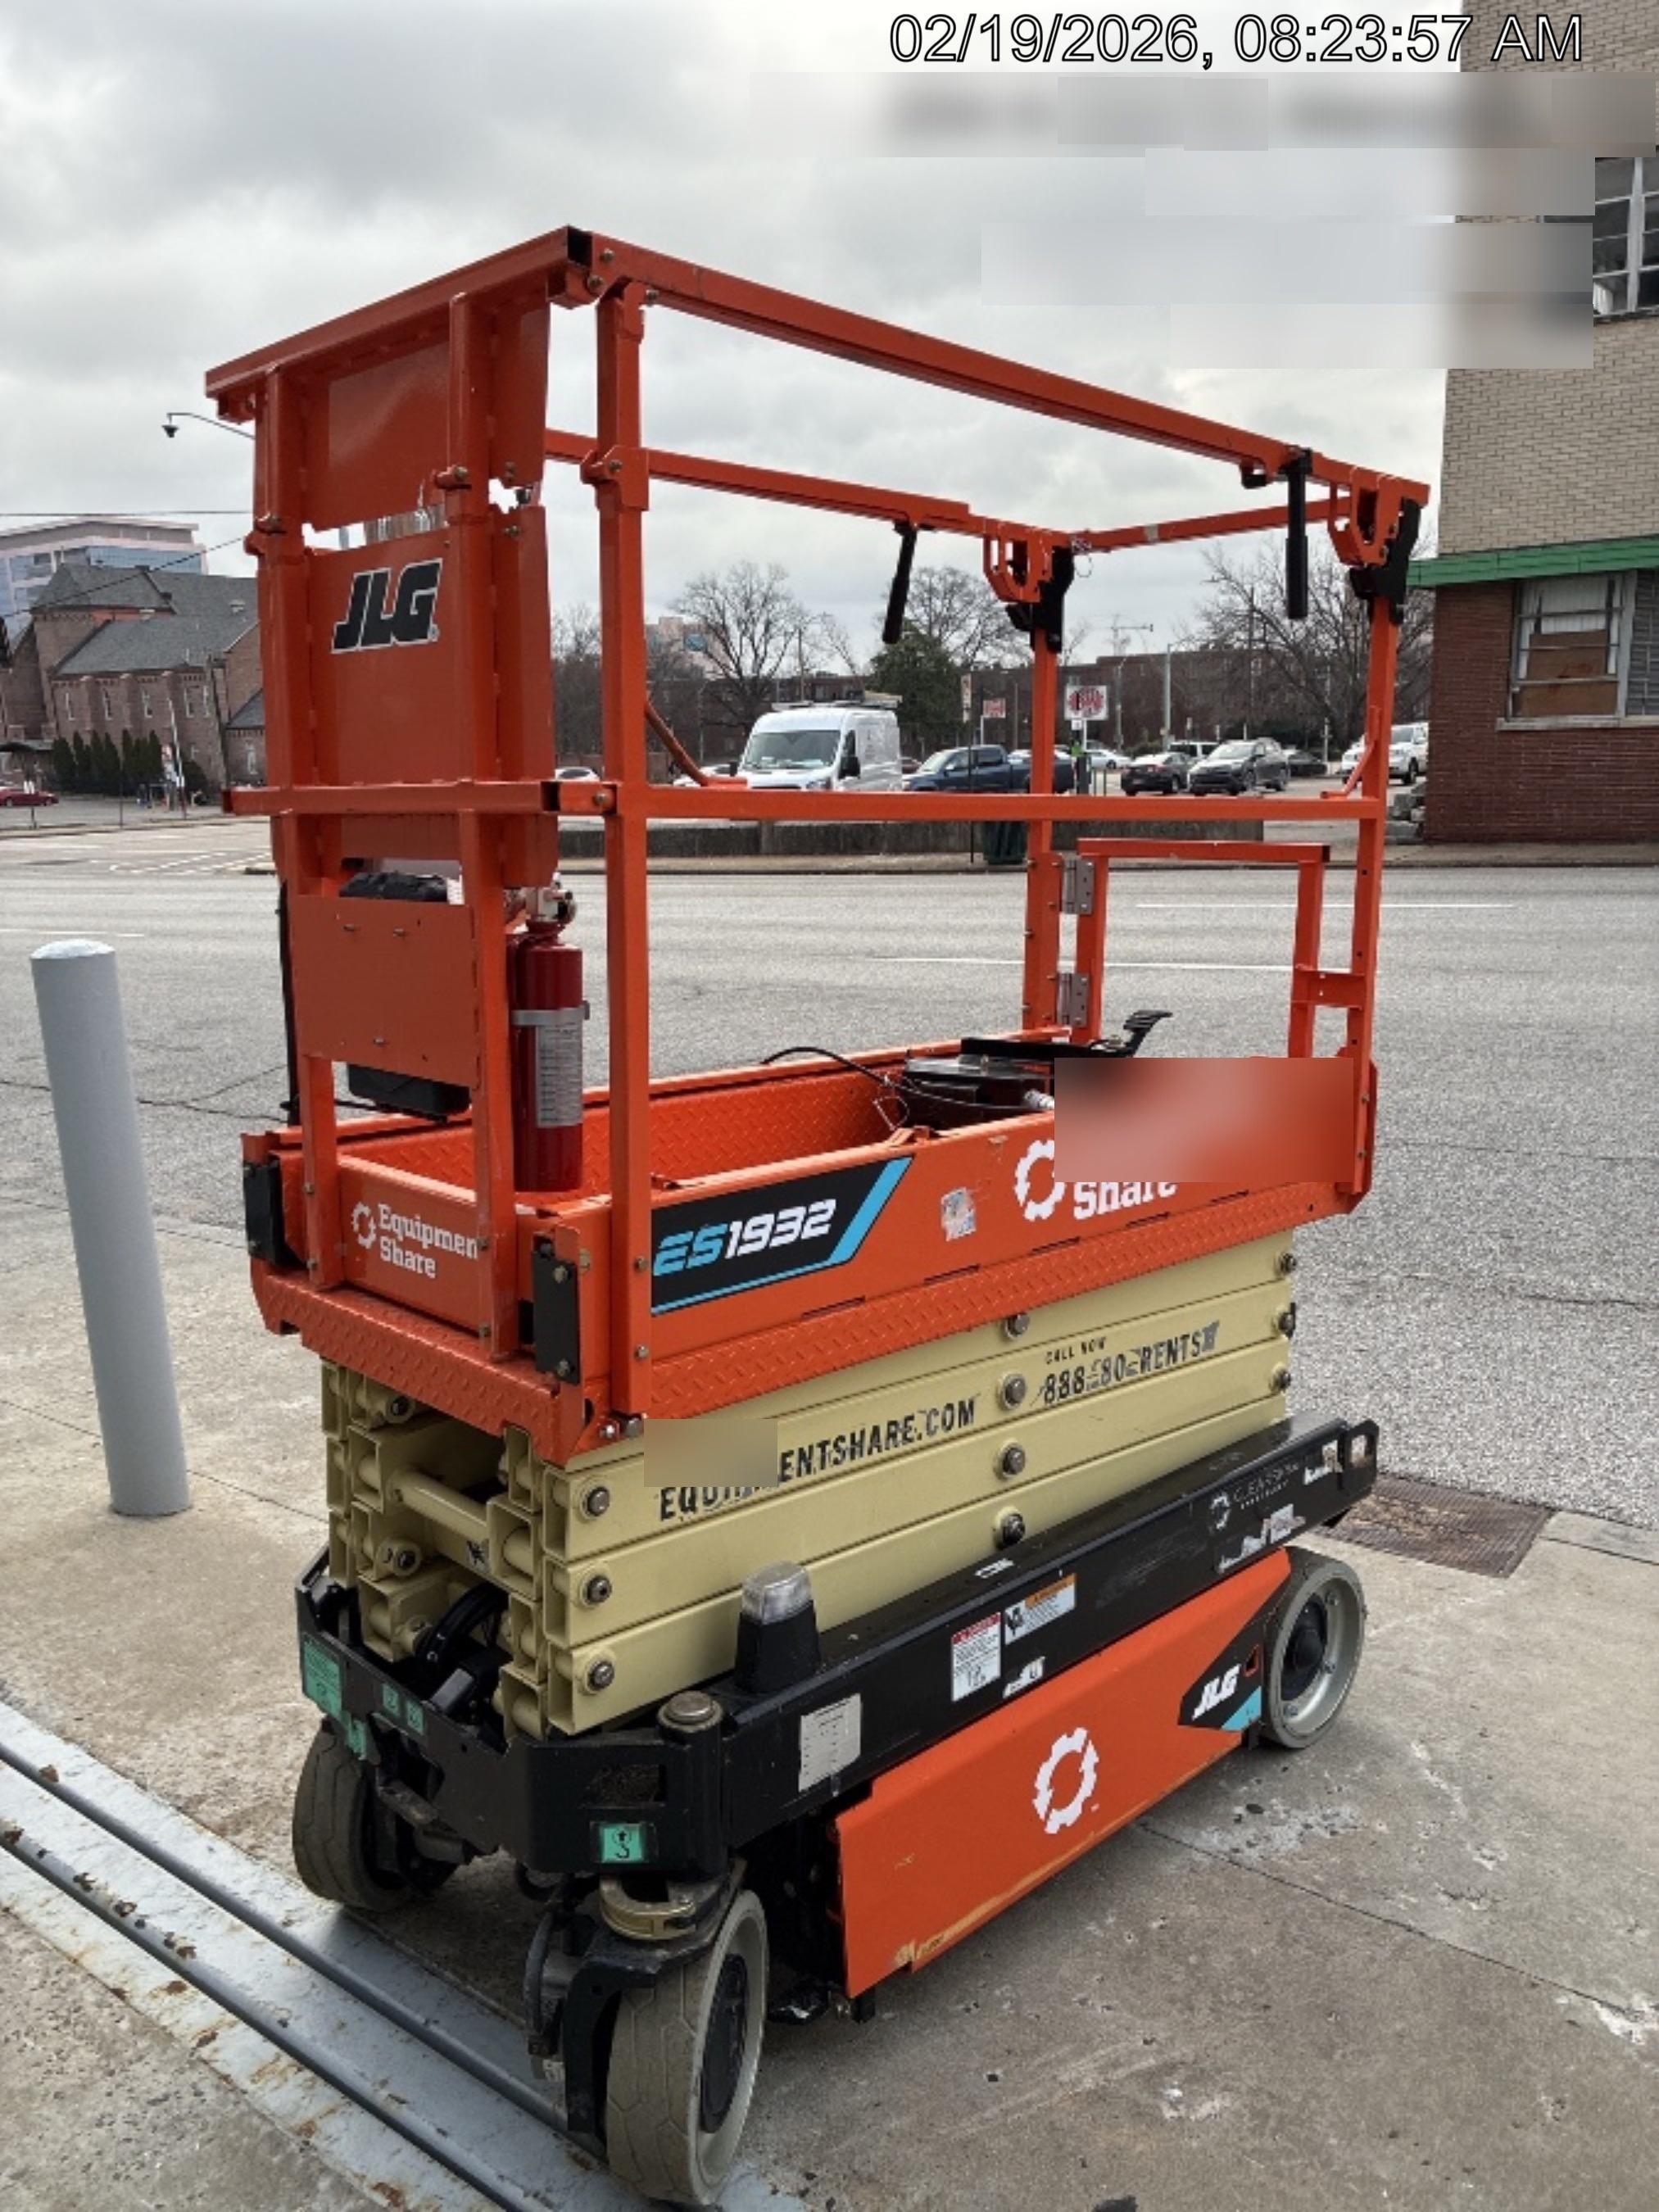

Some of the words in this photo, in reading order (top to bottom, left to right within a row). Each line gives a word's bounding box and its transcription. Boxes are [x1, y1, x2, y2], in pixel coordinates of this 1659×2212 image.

[331, 559, 442, 653] JLG
[378, 1203, 478, 1258] Equipmen
[380, 1238, 436, 1278] Share
[653, 1199, 836, 1276] ES1932
[660, 1398, 975, 1521] EQUENTSHARE.COM
[1191, 1663, 1241, 1720] JLG
